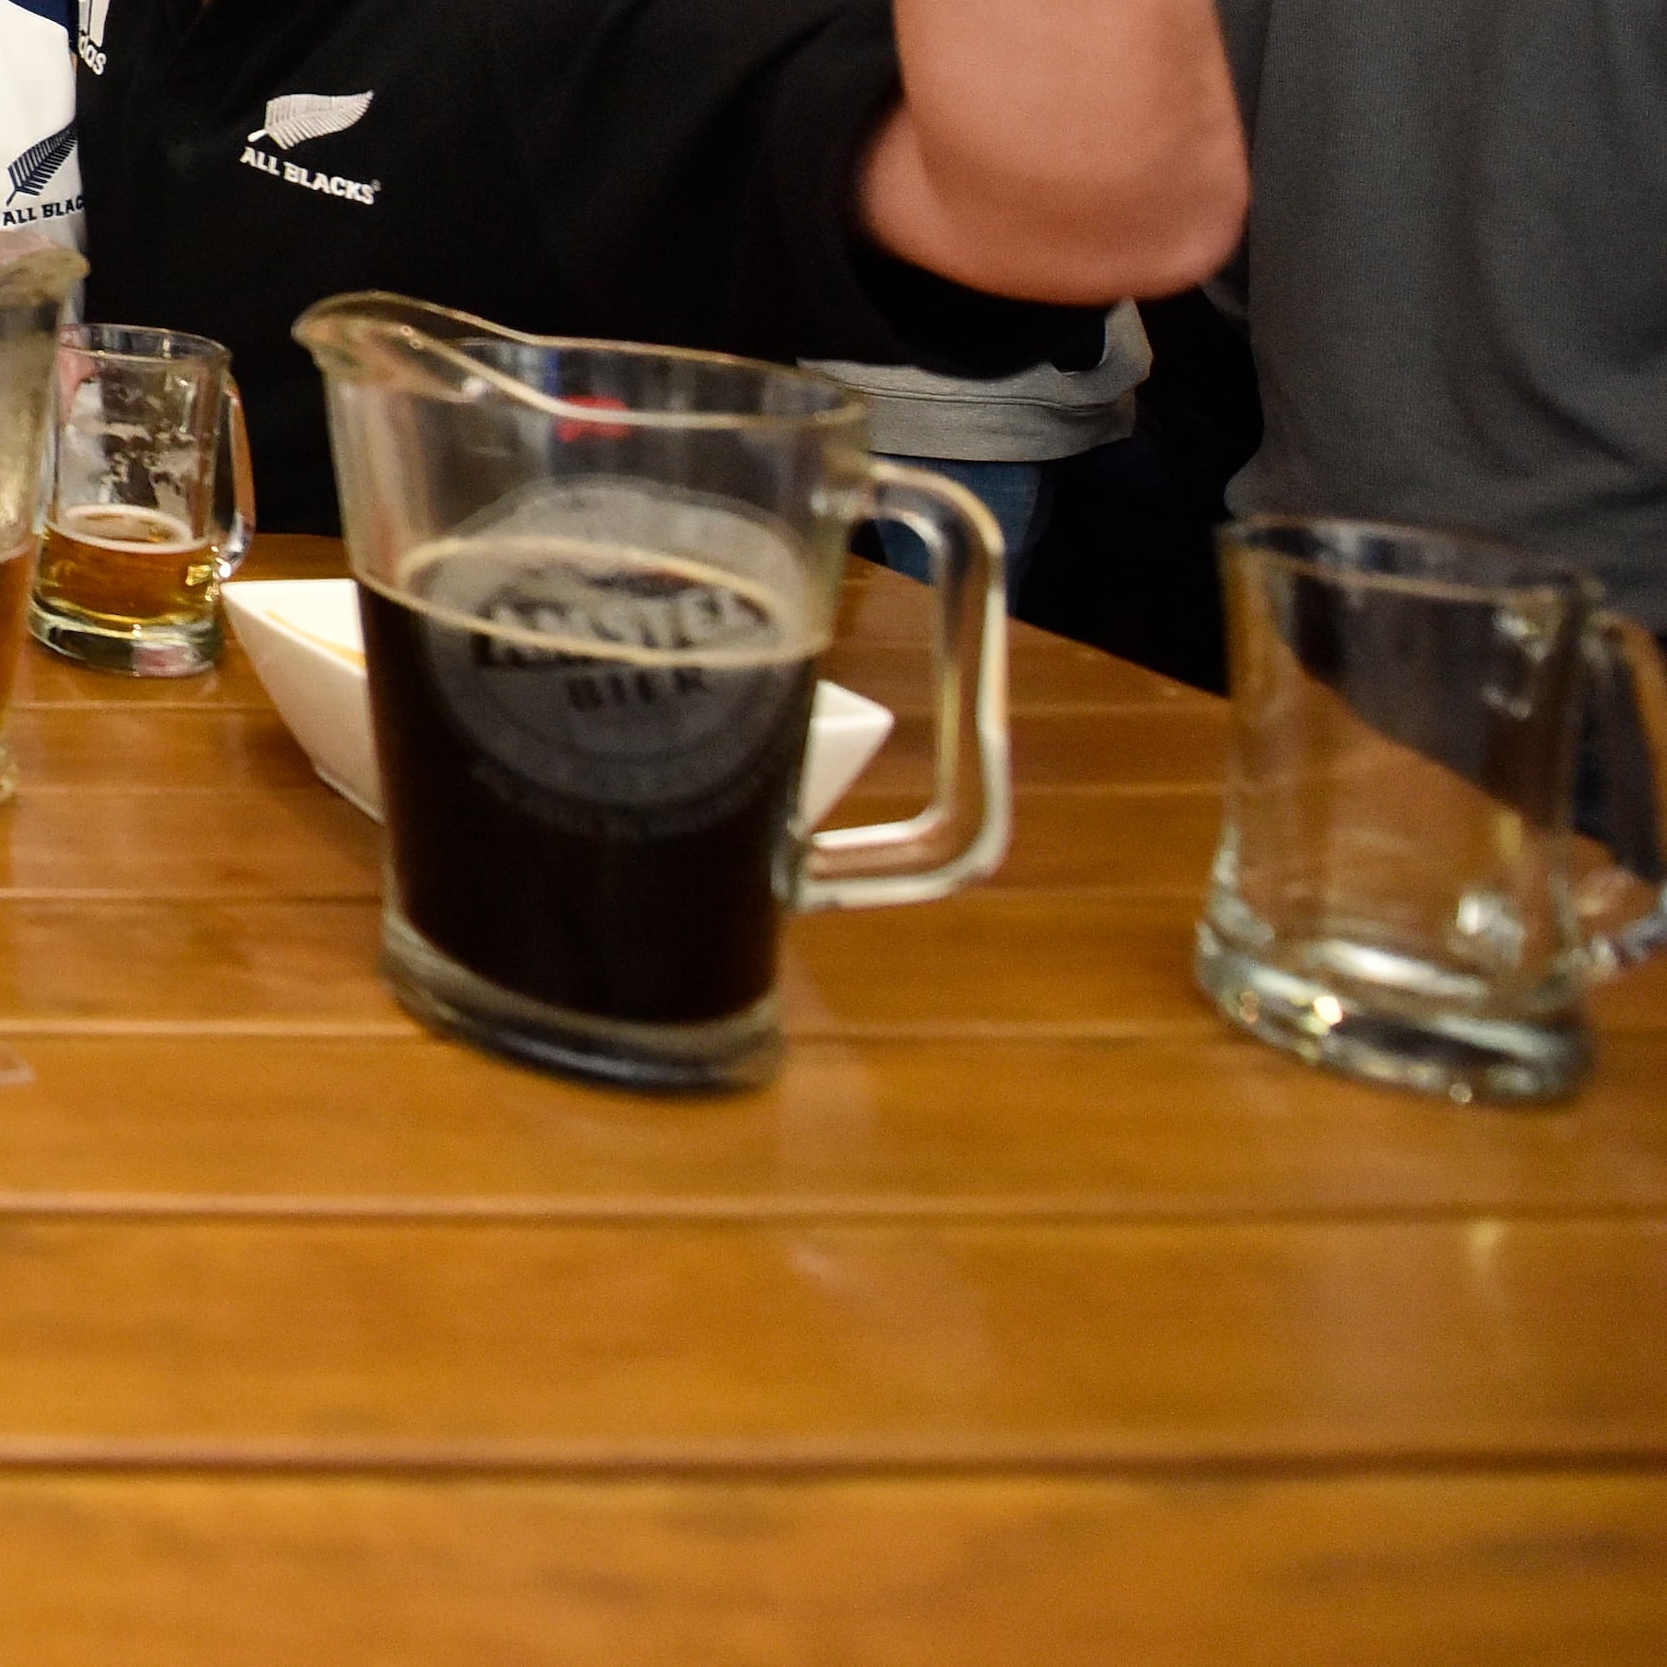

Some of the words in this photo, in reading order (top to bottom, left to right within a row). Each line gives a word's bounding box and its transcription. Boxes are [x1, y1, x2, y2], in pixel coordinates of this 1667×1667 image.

[78, 34, 107, 76] das
[239, 146, 281, 176] ALL
[283, 160, 376, 206] BLACKS
[2, 207, 38, 227] ALL
[41, 194, 85, 219] BLAC
